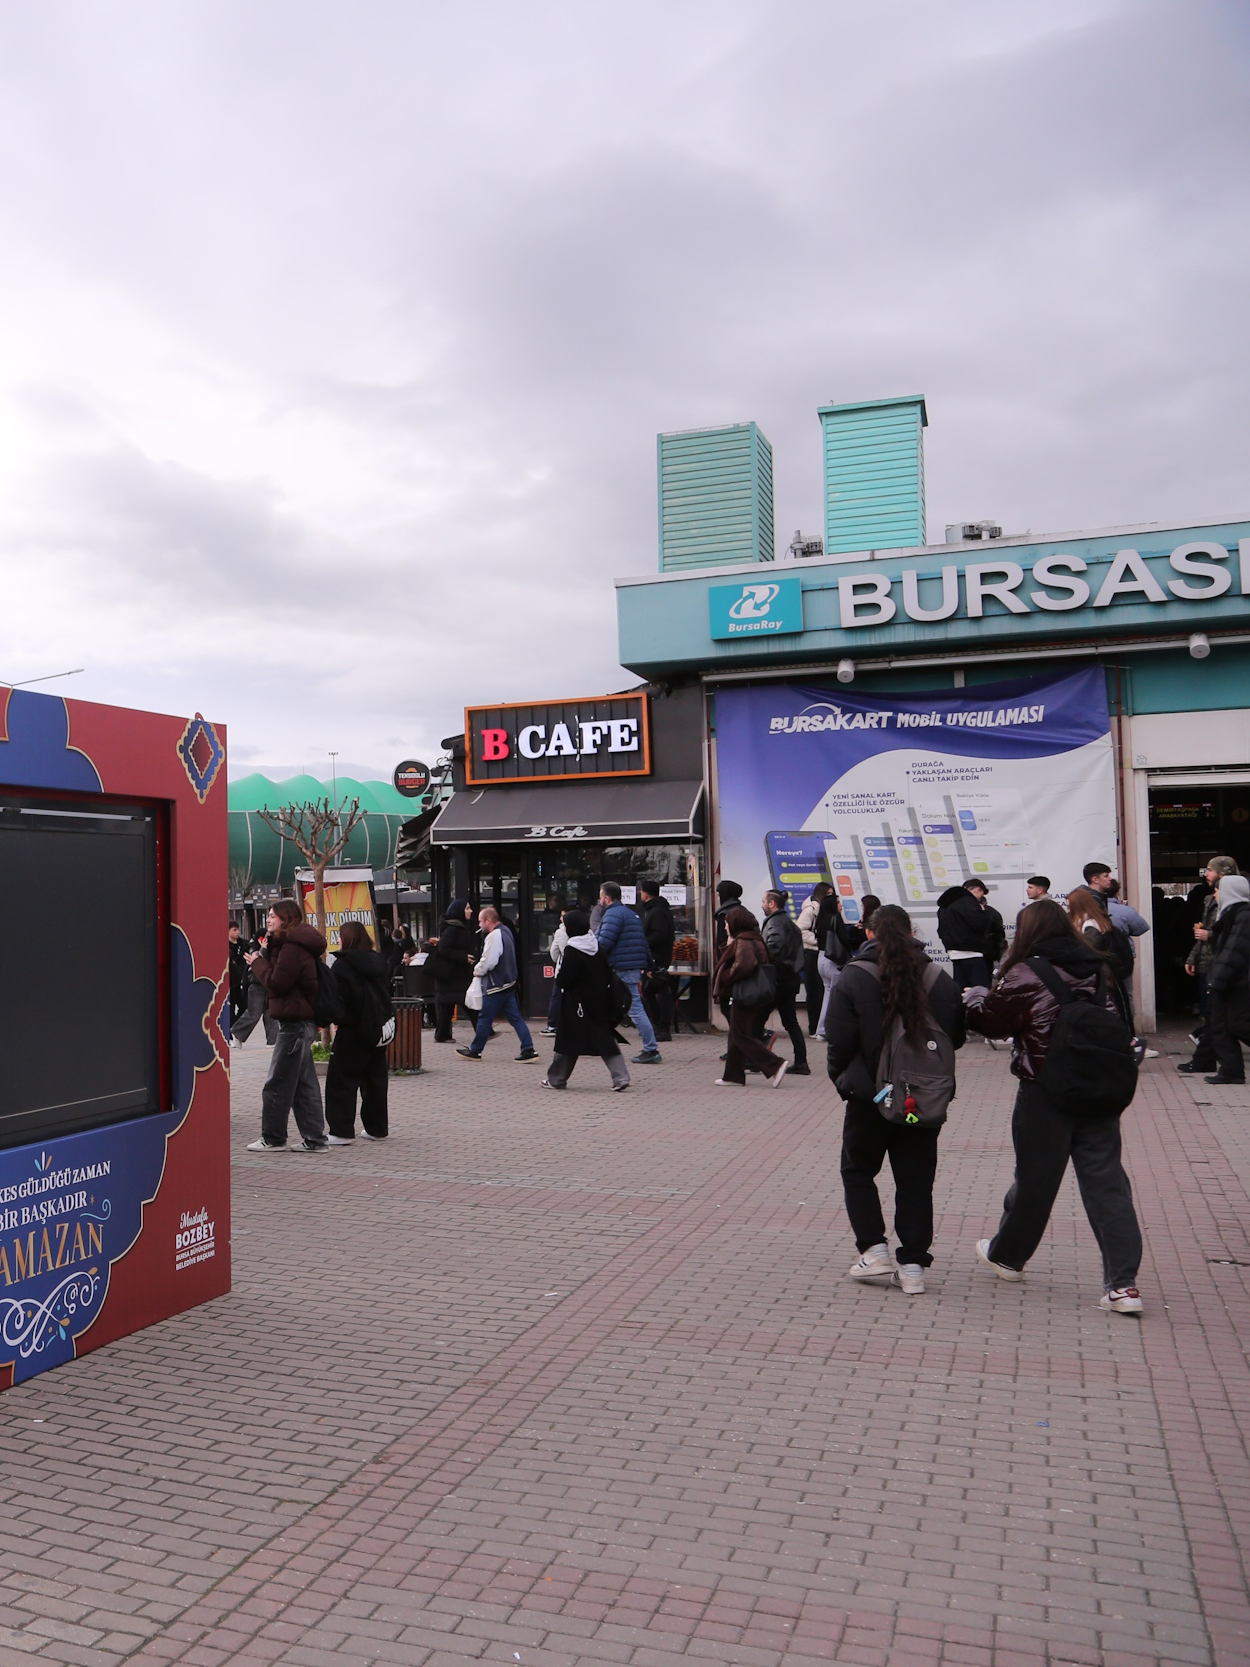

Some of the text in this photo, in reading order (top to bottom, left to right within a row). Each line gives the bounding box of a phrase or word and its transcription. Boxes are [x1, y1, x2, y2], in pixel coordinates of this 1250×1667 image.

[728, 620, 783, 633] BursaRay
[769, 704, 1045, 735] BURSAKART MOBİL UYGULAMASI
[481, 718, 639, 761] B CAFE
[911, 760, 944, 769] DURAĞA
[911, 766, 993, 776] YAKLAŞAN ARAÇLARI
[398, 778, 426, 786] BURGER
[936, 774, 959, 782] TAKİP
[832, 792, 849, 800] YENİ
[832, 799, 865, 807] ÖZELLİĞİ
[879, 797, 905, 806] ÖZGÜR
[525, 826, 588, 839] B Cafe
[776, 849, 803, 857] Nereye?
[306, 908, 373, 927] TAUK DÜRÜM
[543, 965, 554, 978] B
[18, 1168, 72, 1198] GÜLDÜĞÜ
[72, 1160, 111, 1184] ZAMAN
[21, 1190, 88, 1225] BAŞKADIR
[179, 1206, 209, 1229] Mustafa
[176, 1221, 215, 1249] BOZBEY
